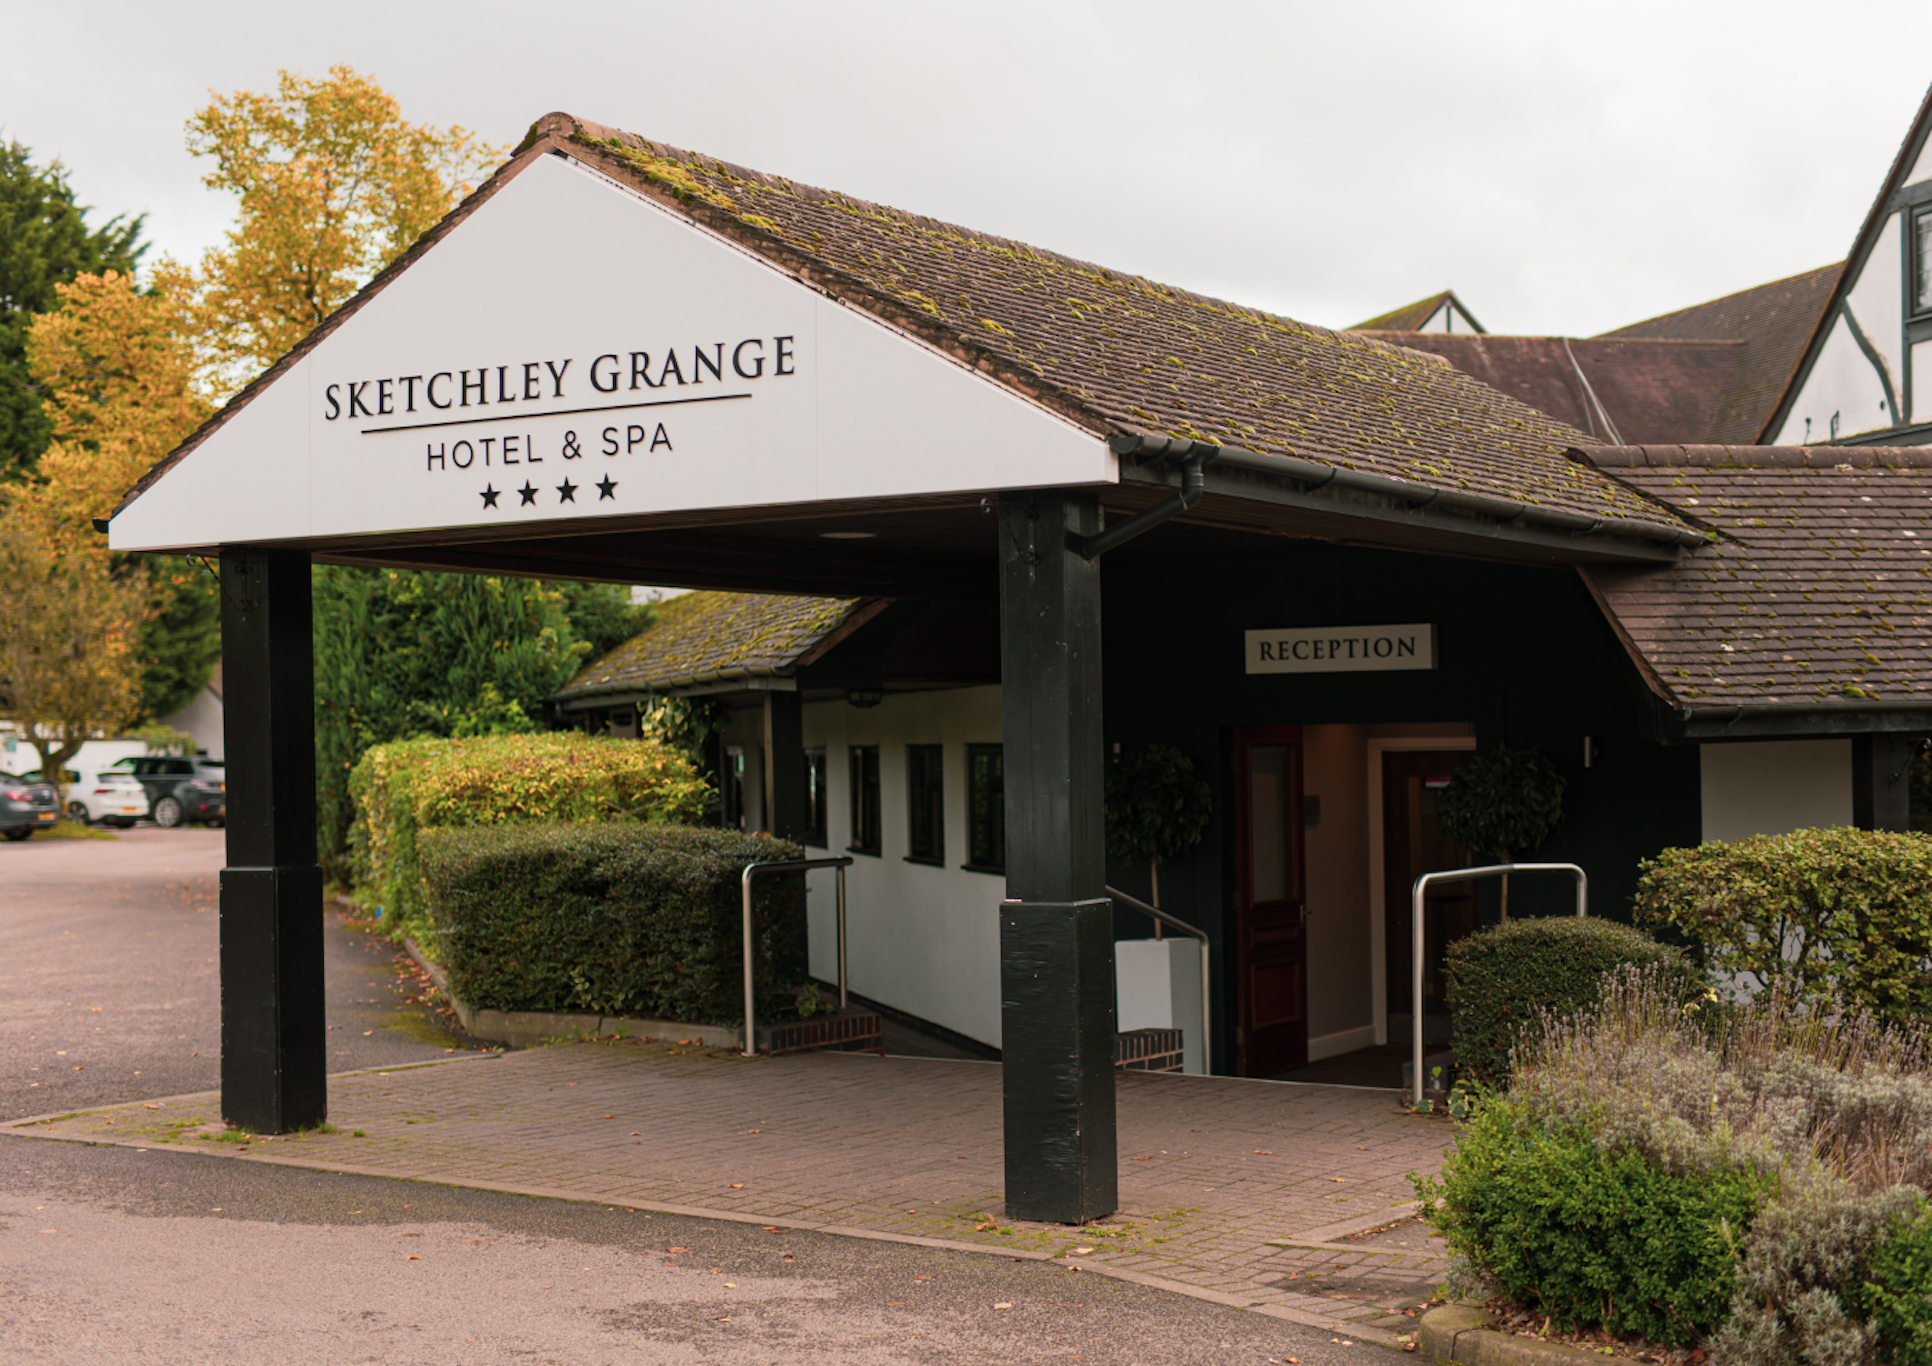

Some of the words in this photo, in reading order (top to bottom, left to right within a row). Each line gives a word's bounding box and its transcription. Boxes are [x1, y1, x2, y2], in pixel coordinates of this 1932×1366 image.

[325, 358, 573, 421] SKETCHLEY
[589, 335, 796, 393] GRANGE
[427, 434, 543, 472] HOTEL
[562, 430, 582, 460] &
[601, 422, 673, 457] SPA
[1258, 636, 1416, 662] RECEPTION
